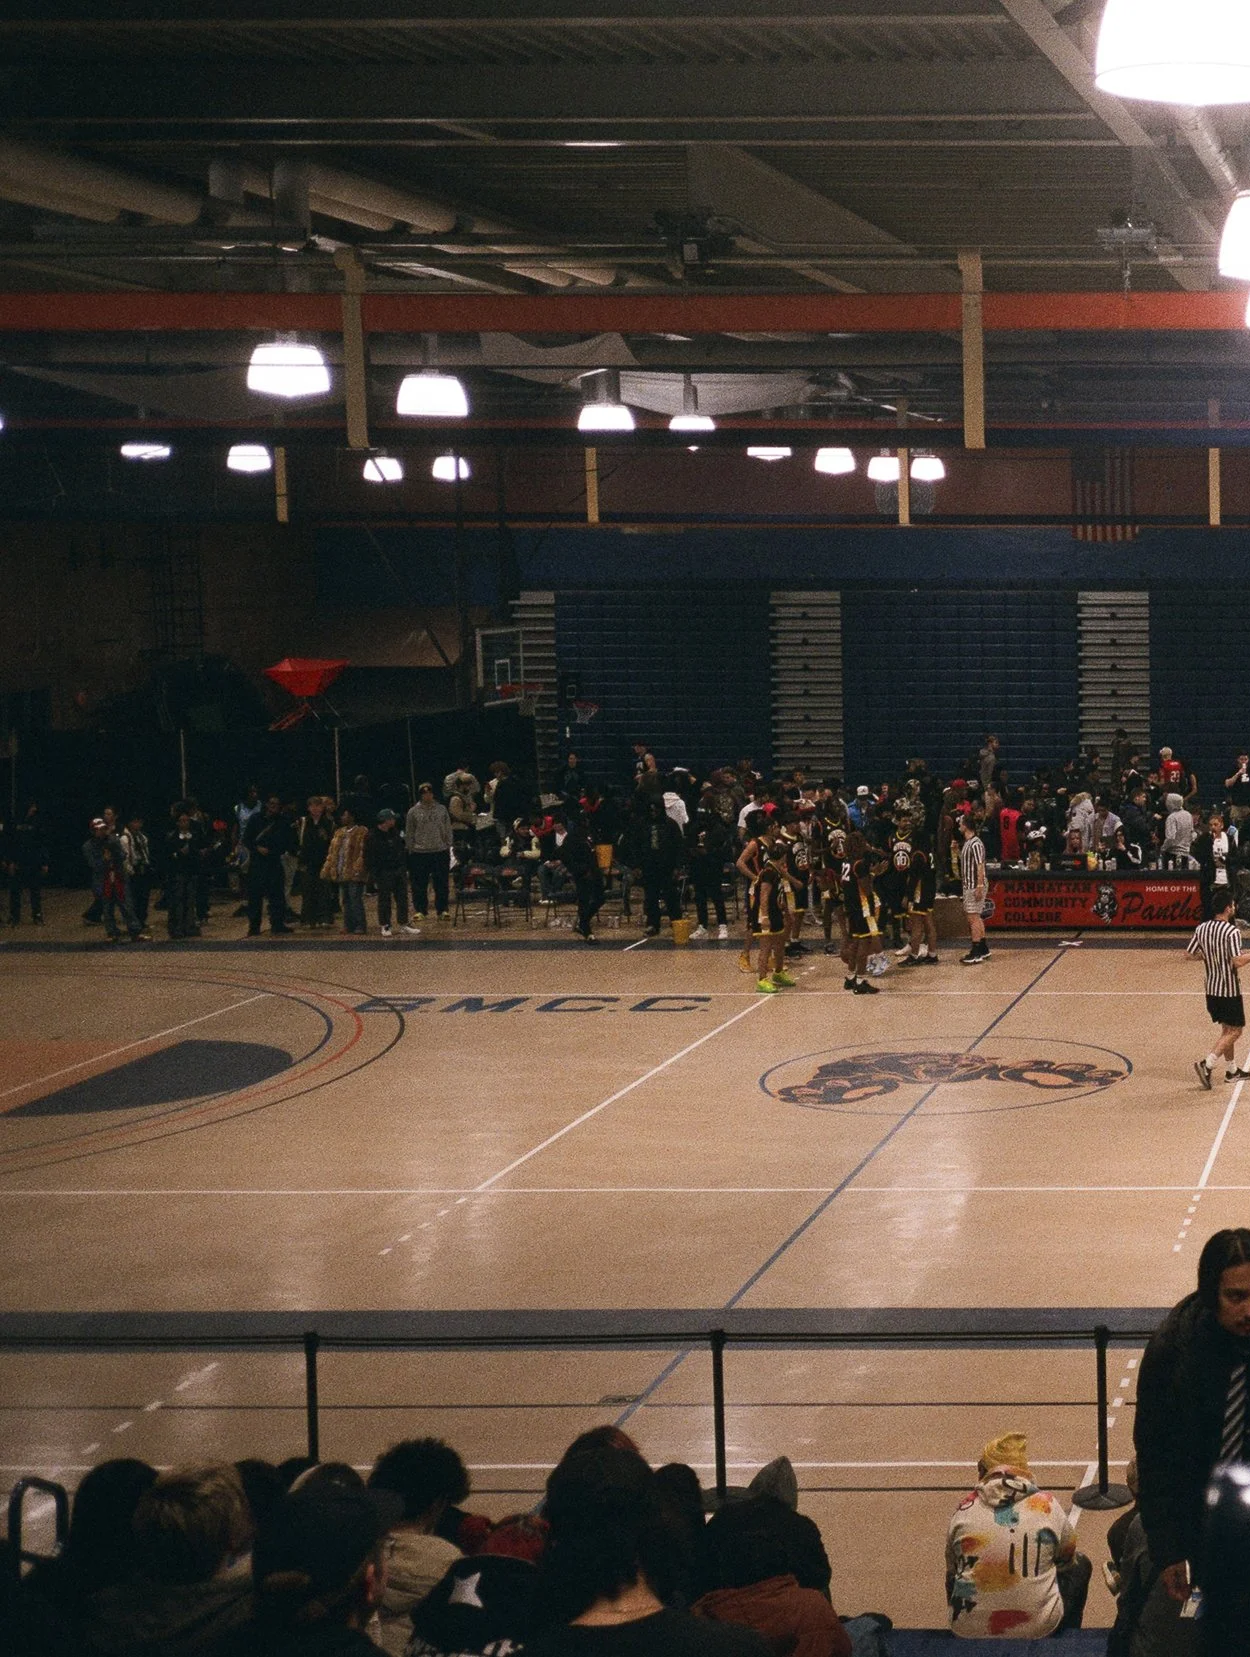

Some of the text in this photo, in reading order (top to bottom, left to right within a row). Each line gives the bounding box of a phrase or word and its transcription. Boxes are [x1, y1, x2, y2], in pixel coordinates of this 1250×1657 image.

[1003, 881, 1092, 893] MANHATTAN
[1145, 885, 1197, 893] HOME OF THE
[1003, 897, 1089, 908] COMMUNITY
[1121, 889, 1204, 922] Panthe
[1004, 911, 1061, 923] COLLEGE
